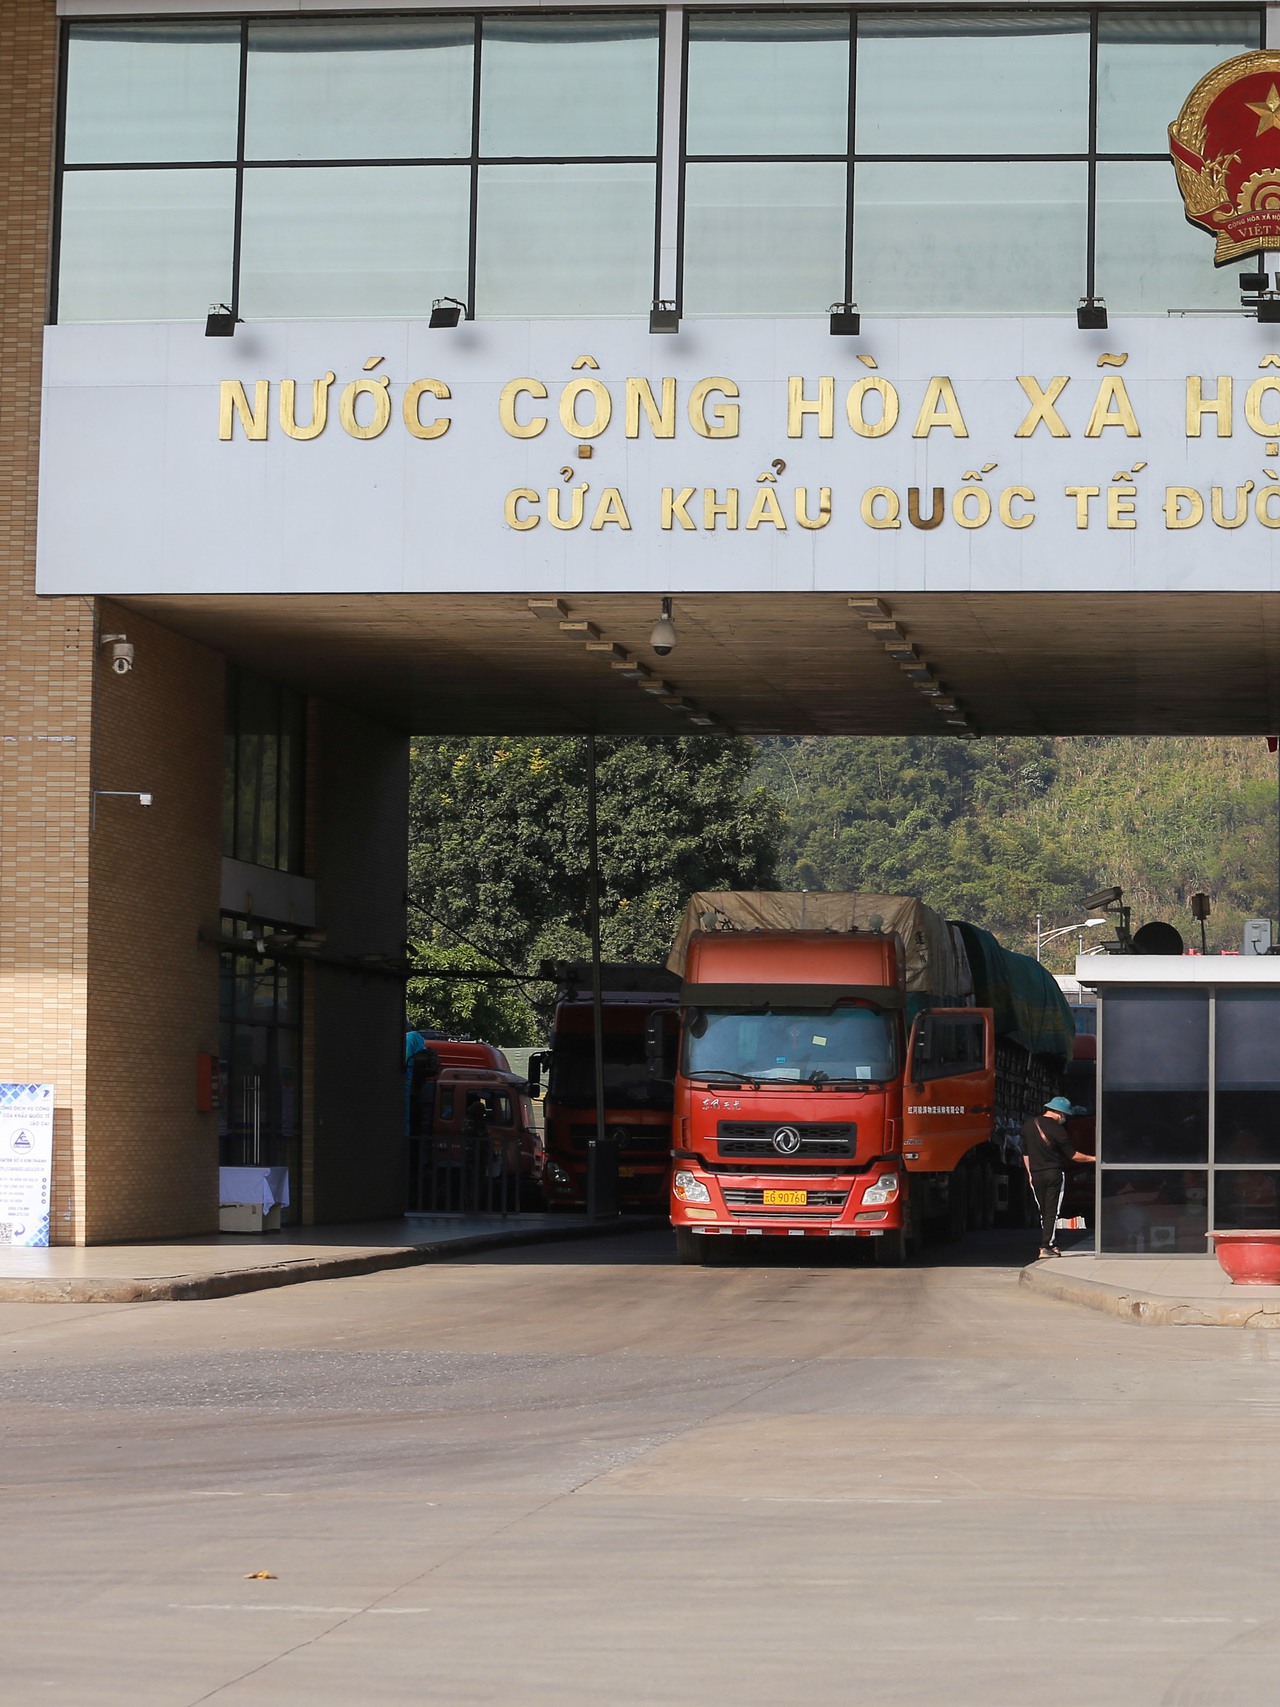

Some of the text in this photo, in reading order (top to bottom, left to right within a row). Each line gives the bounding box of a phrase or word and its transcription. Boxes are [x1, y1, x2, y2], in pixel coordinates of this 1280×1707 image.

[219, 357, 451, 440] NƯỚC
[499, 356, 740, 459] CỘNG
[787, 355, 969, 439] HÒA
[1015, 353, 1141, 439] XÃ
[504, 466, 631, 530] CỬA
[662, 460, 832, 530] KHẨU
[861, 463, 1035, 530] QUỐC
[1066, 463, 1147, 530] TẾ
[778, 1192, 806, 1203] 90760
